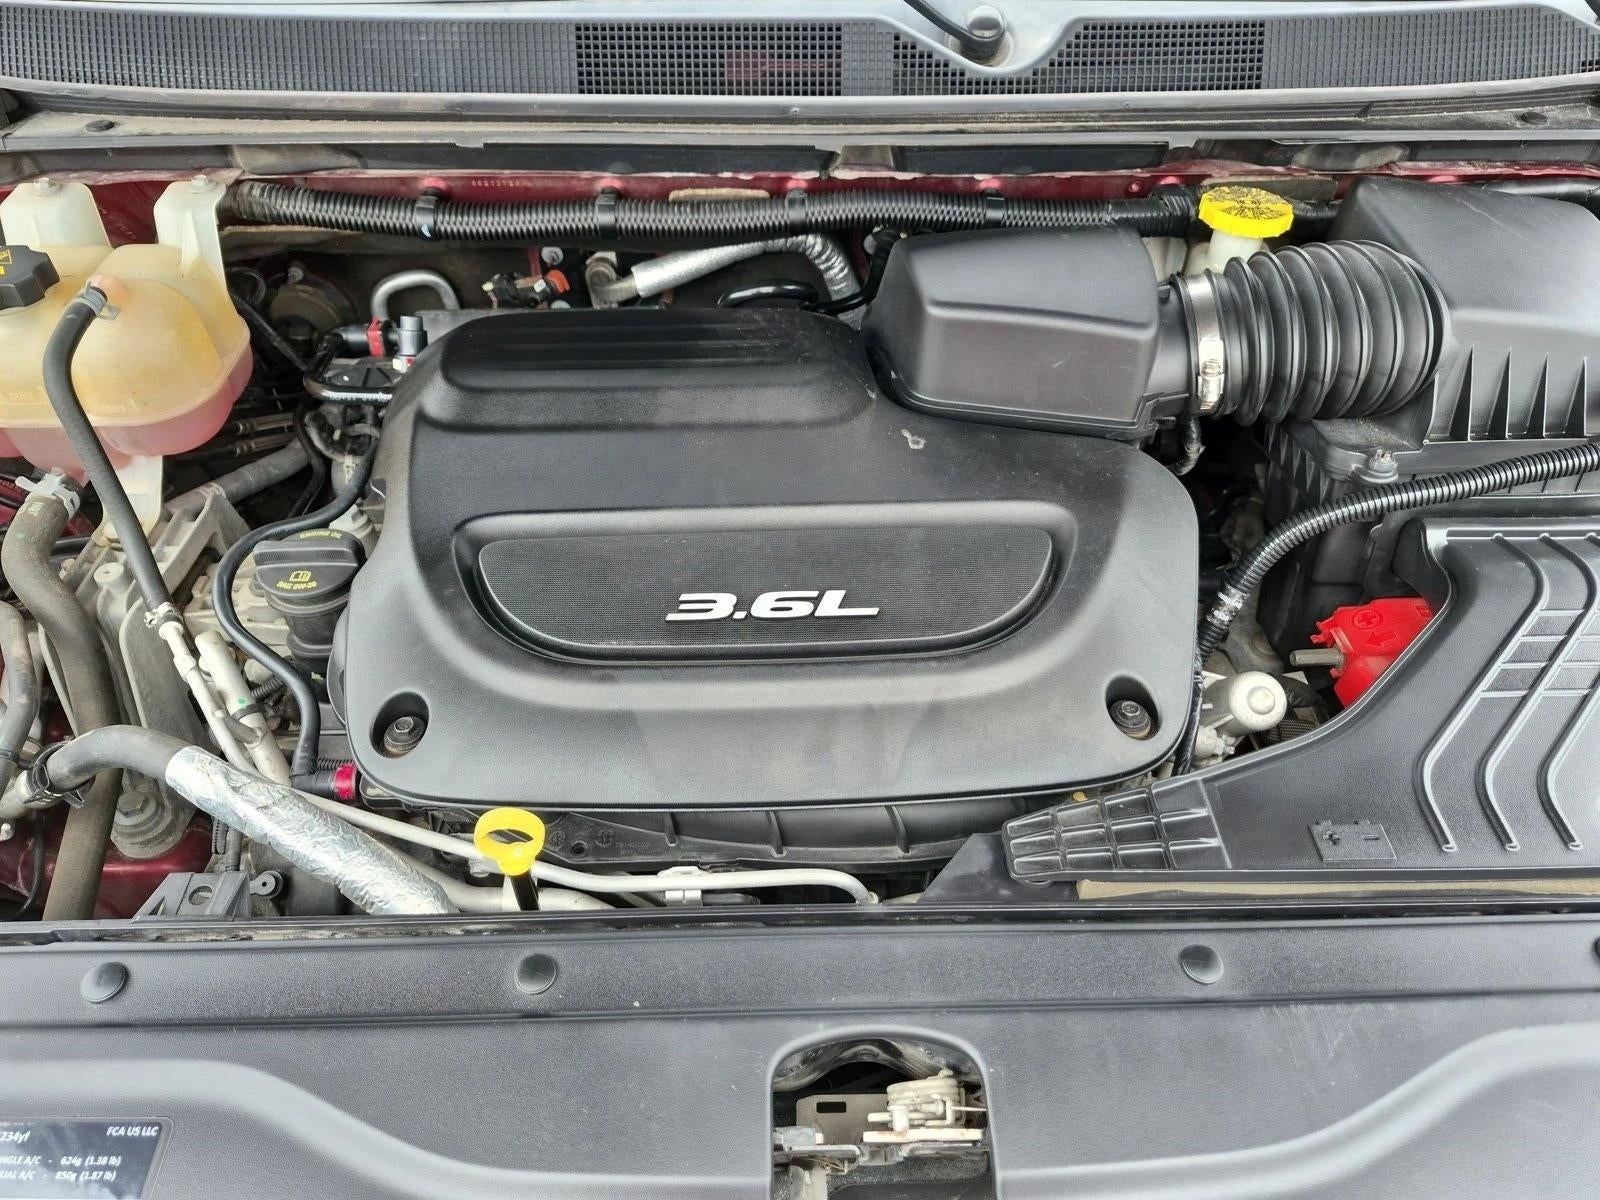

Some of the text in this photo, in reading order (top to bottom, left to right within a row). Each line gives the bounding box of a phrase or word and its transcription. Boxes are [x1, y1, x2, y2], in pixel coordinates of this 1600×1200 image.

[665, 590, 880, 621] 3.6L
[0, 1131, 30, 1143] 234yf
[106, 1126, 159, 1137] FCA US LLC
[23, 1155, 42, 1166] A/C
